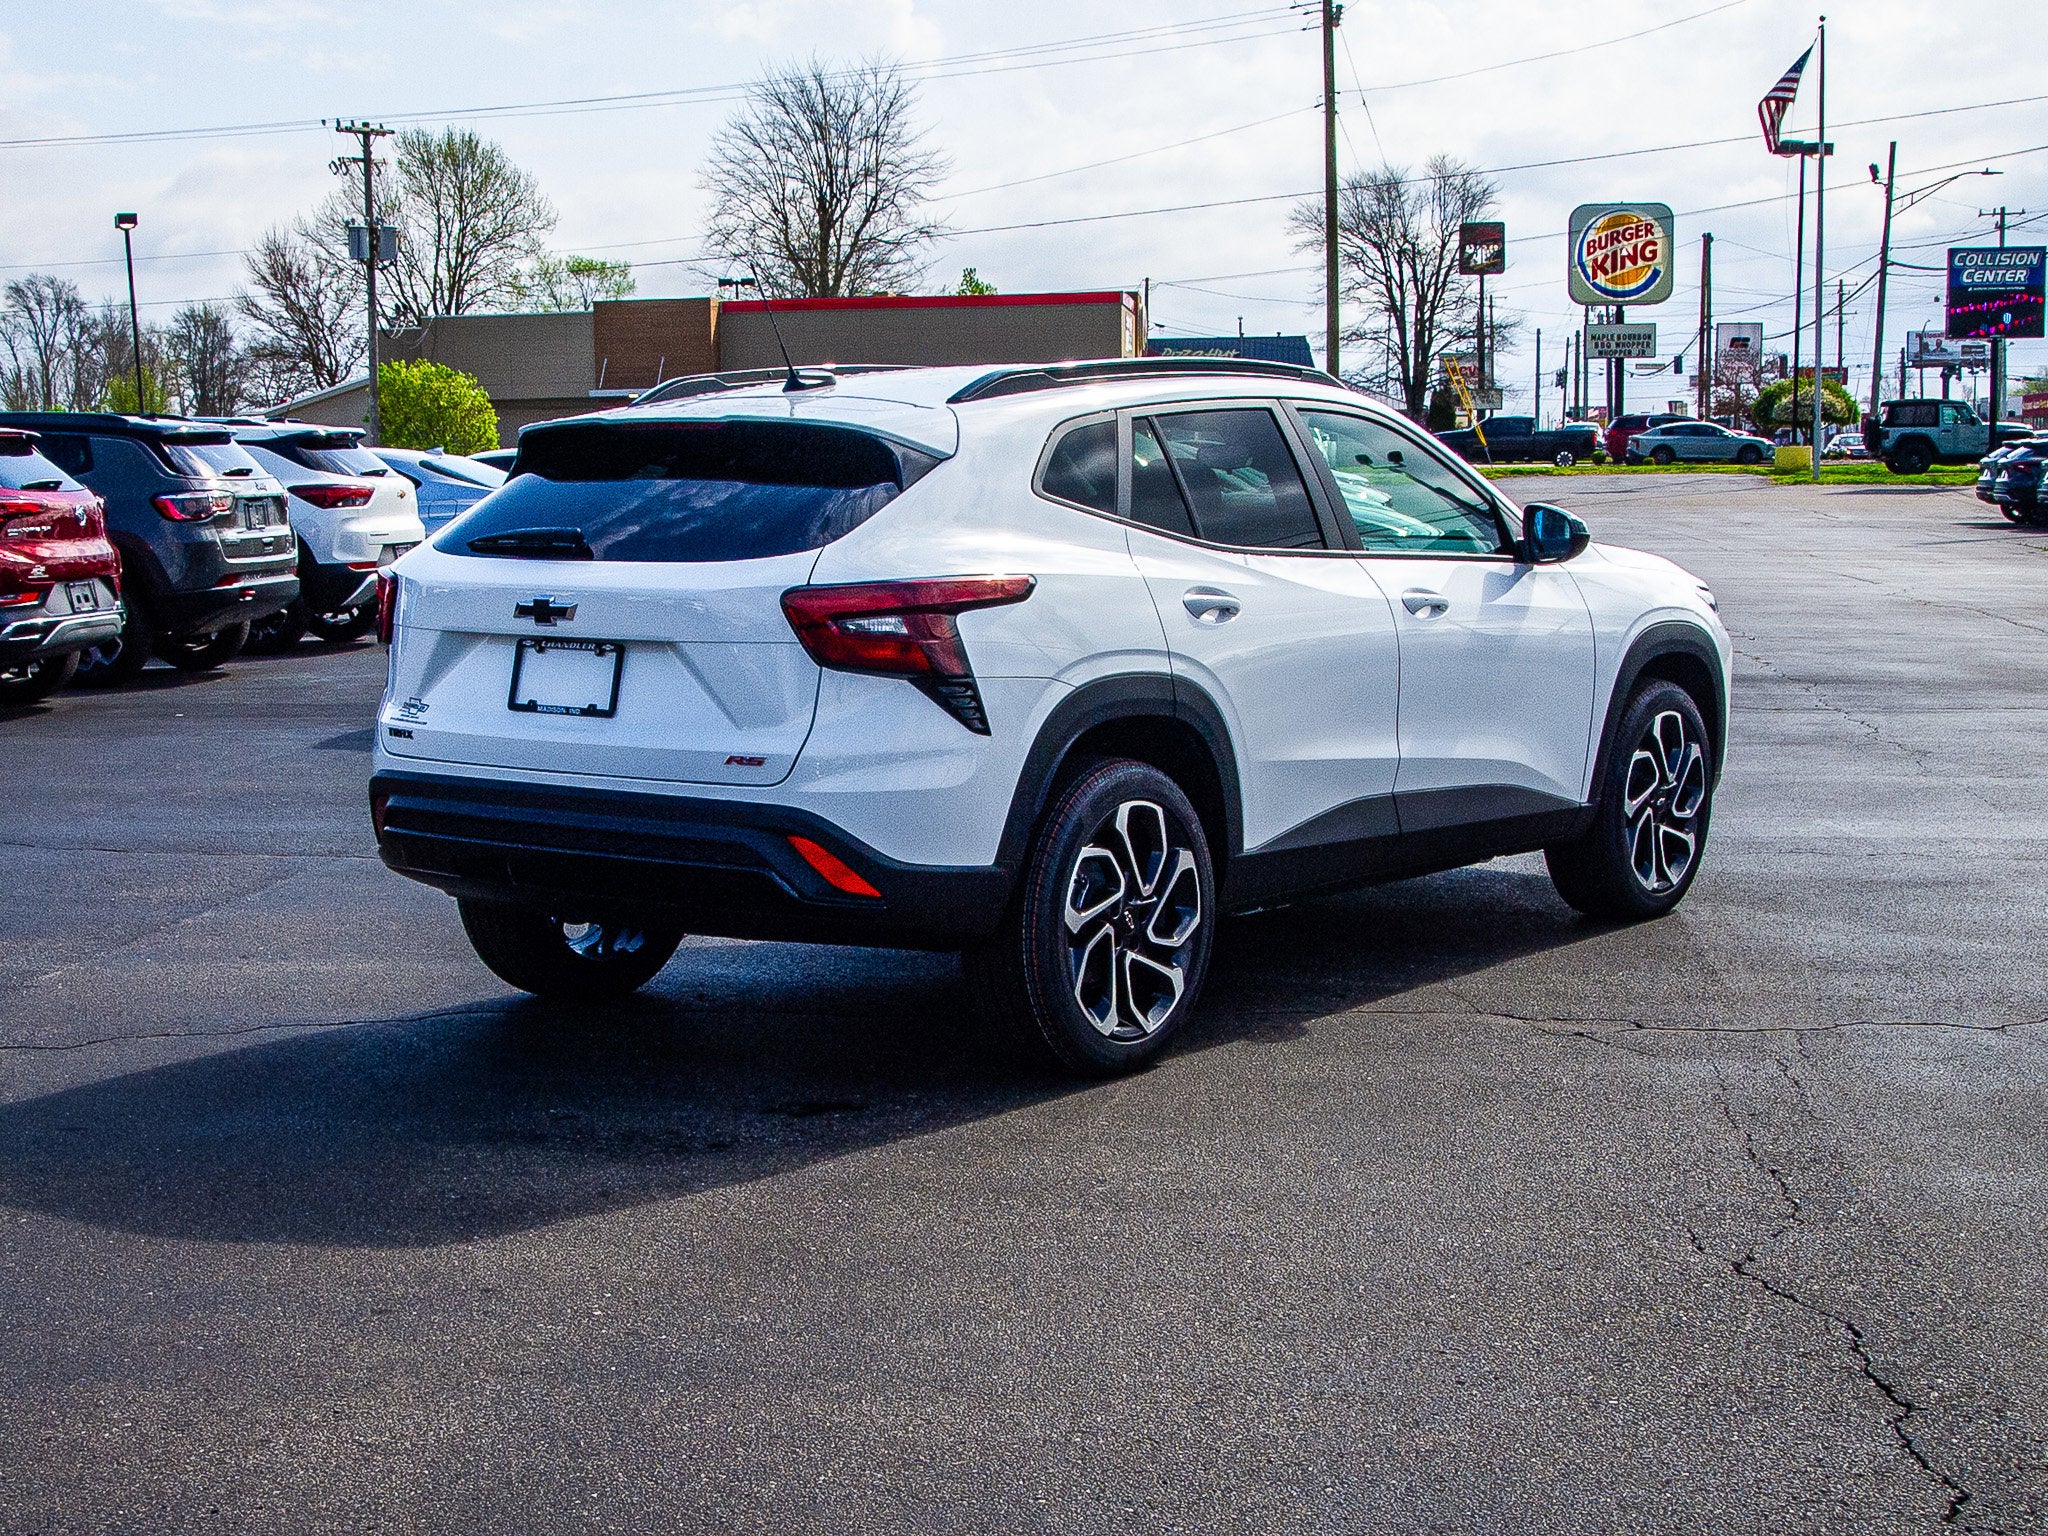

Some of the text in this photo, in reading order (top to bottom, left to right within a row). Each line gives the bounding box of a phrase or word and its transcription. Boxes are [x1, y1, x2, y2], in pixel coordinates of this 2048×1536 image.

[1586, 222, 1655, 257] BURGER
[1591, 240, 1658, 281] KING
[1954, 252, 2041, 267] COLLISION
[1962, 268, 2027, 283] CENTER
[1590, 333, 1652, 341] MAPLE BOURBON
[1615, 341, 1651, 349] WHOPPER
[1597, 349, 1632, 357] WHOPPER
[541, 640, 597, 650] CHANDLER
[387, 727, 414, 740] TRAX
[724, 755, 768, 767] RS
